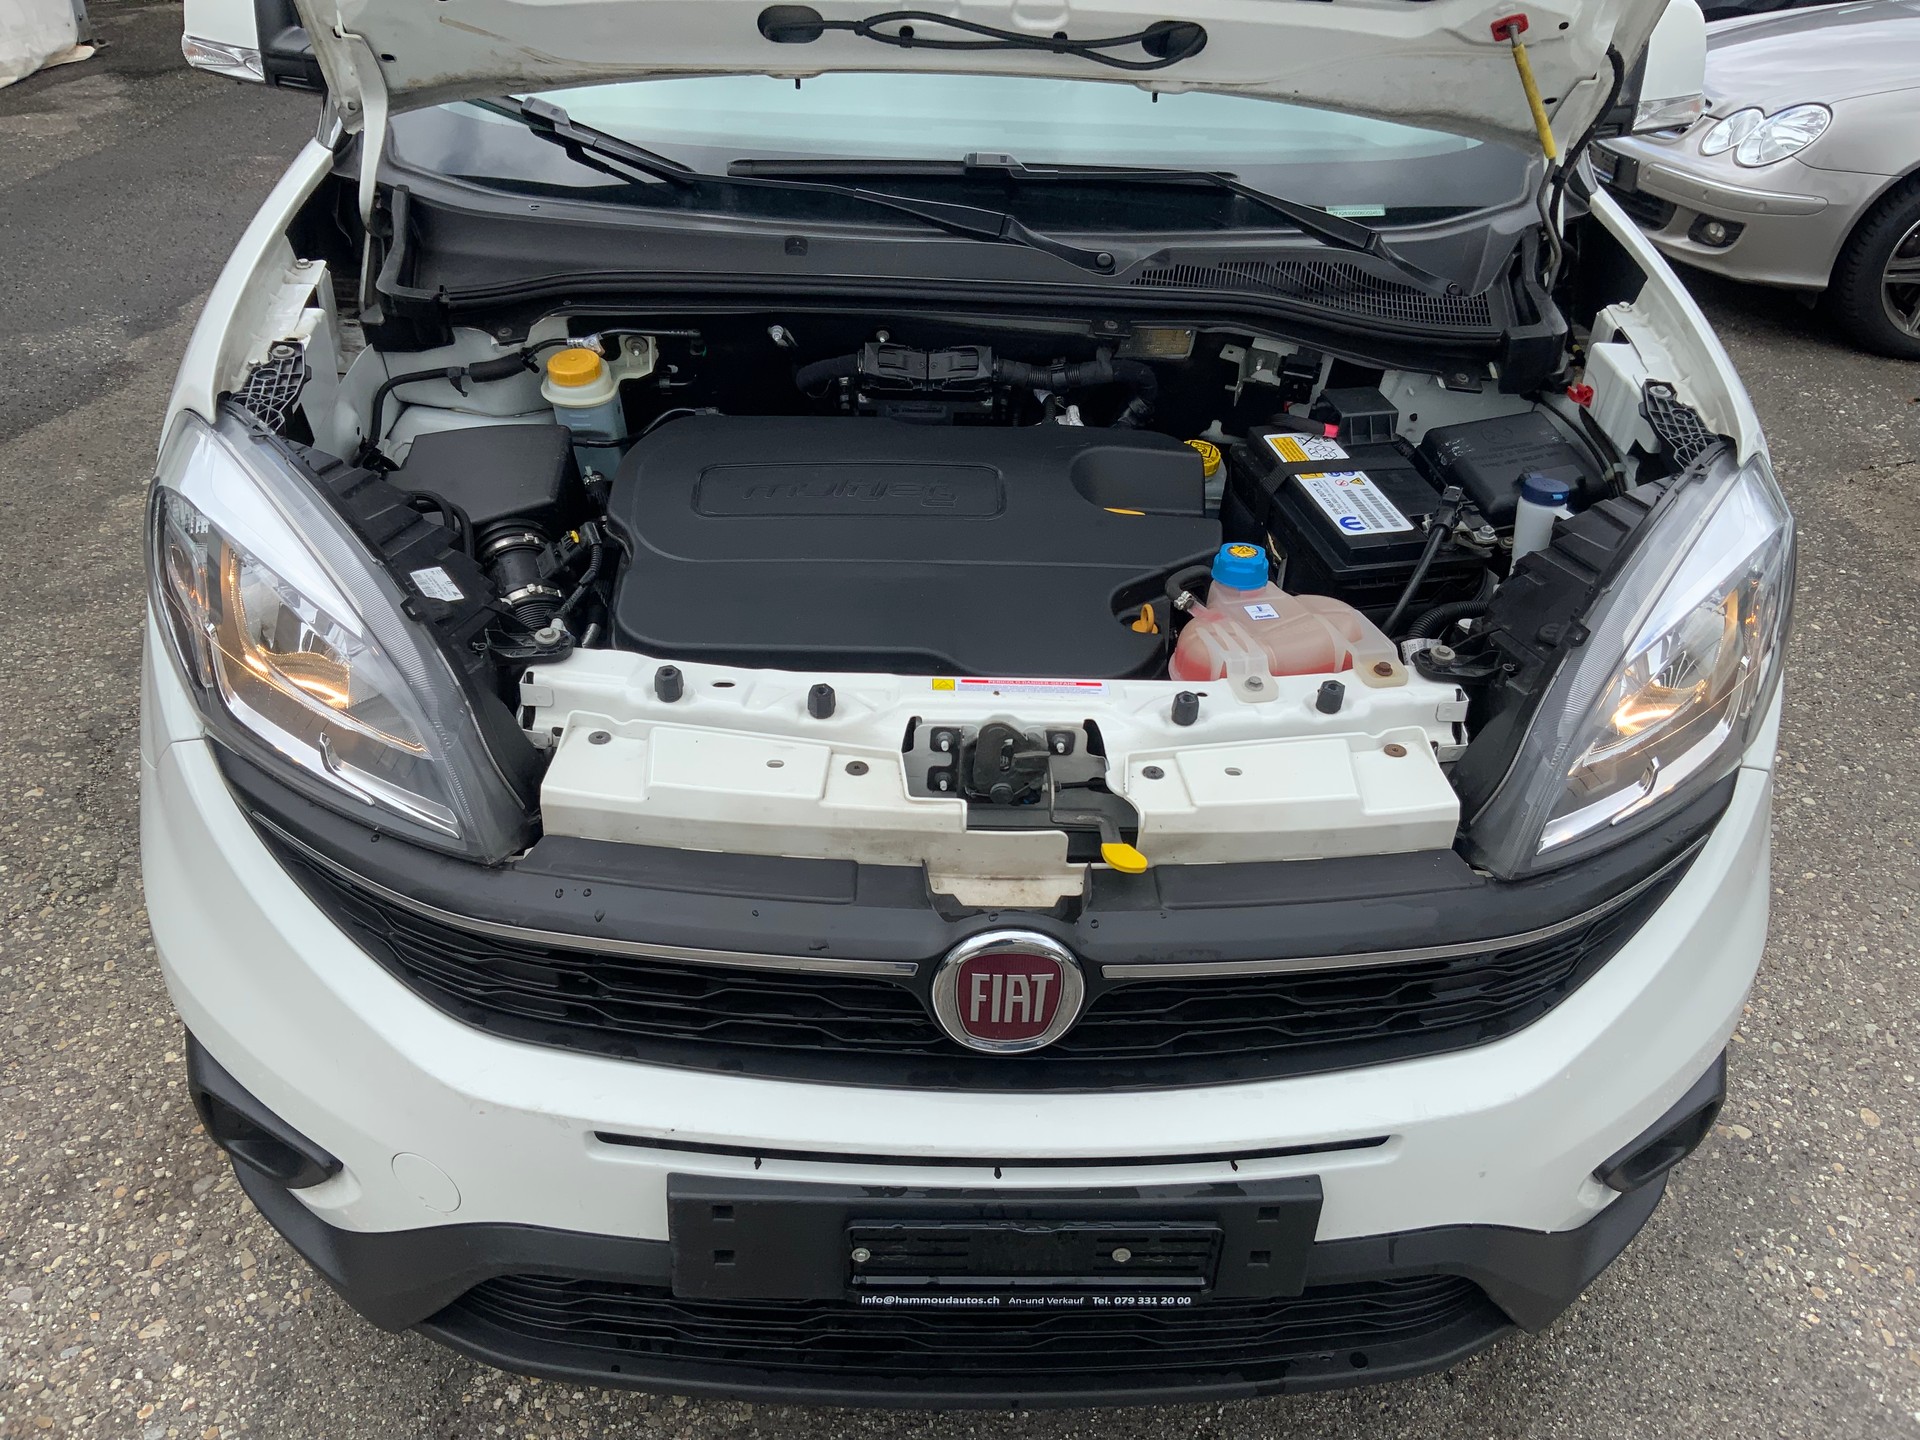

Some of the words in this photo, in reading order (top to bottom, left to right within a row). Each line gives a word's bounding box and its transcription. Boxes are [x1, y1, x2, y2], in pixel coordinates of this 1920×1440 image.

[970, 973, 1055, 1023] FIAT
[1008, 1296, 1044, 1305] An-und
[1047, 1296, 1084, 1305] Verkauf
[1093, 1296, 1111, 1305] Tel.
[1114, 1296, 1135, 1305] 079
[1137, 1296, 1158, 1305] 331
[1160, 1296, 1175, 1305] 20
[1176, 1296, 1192, 1305] 00
